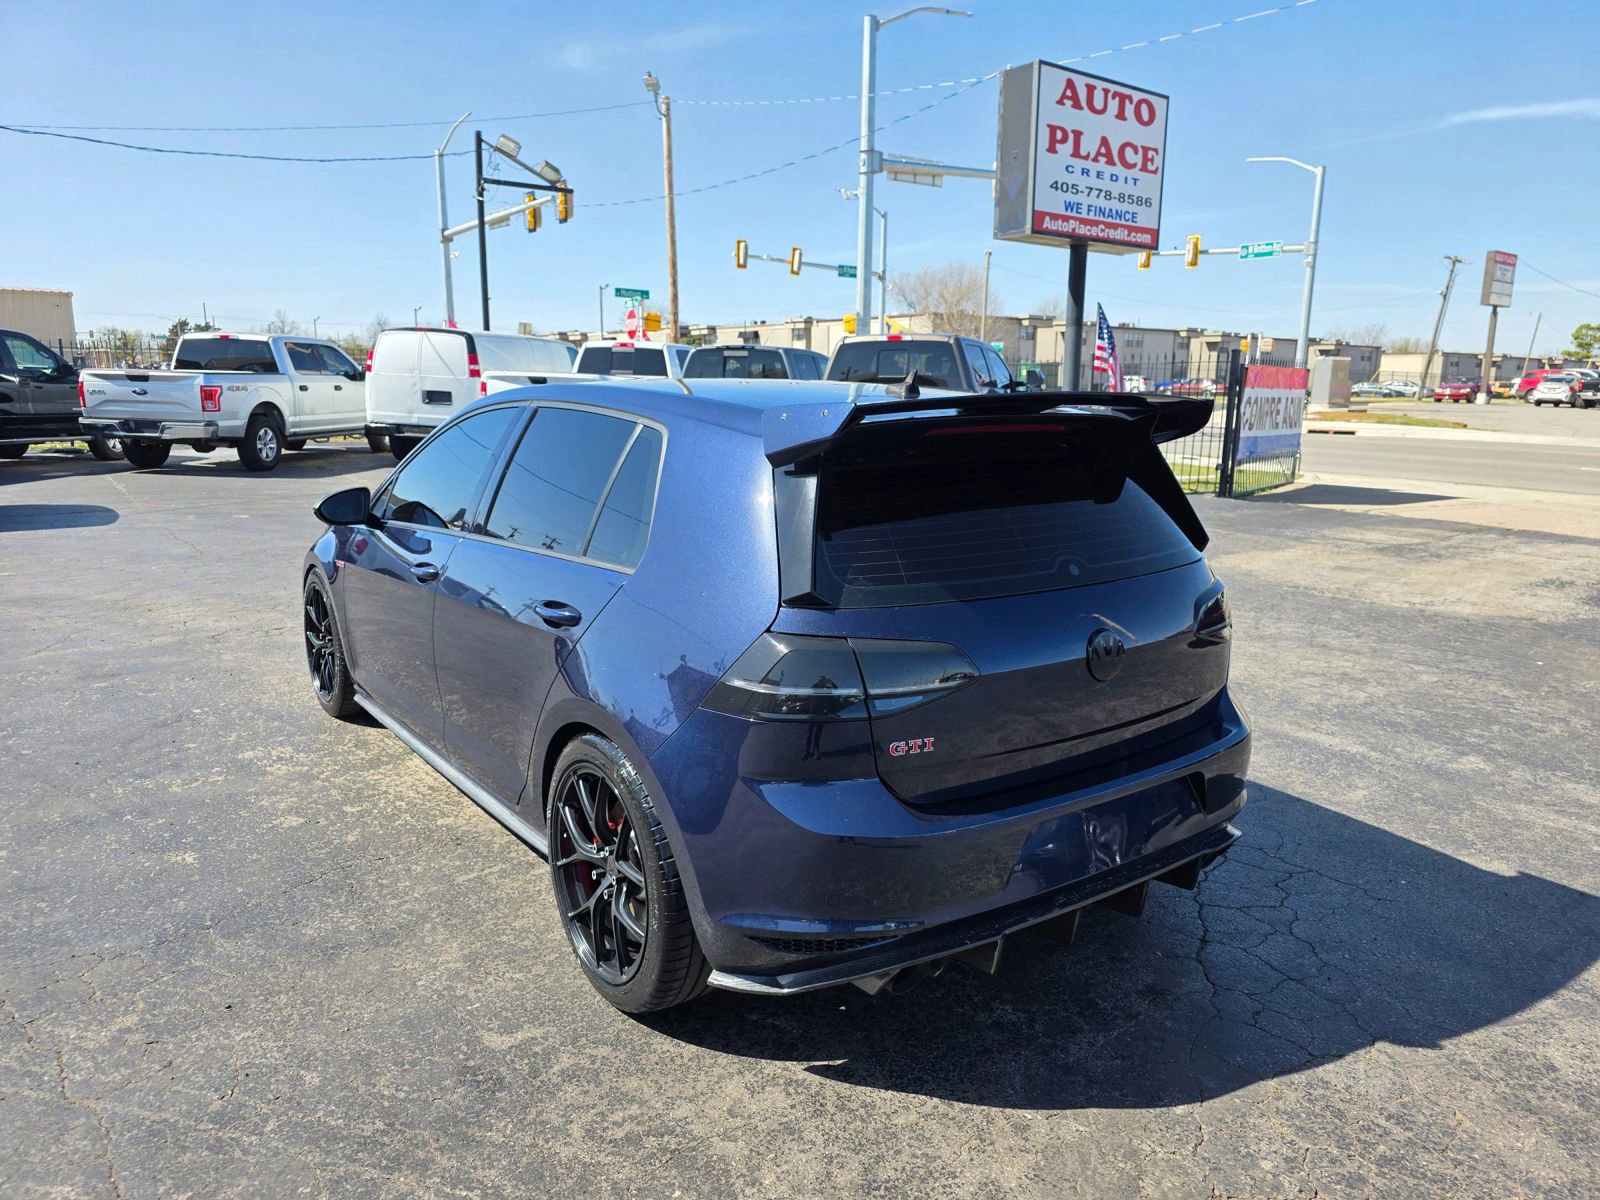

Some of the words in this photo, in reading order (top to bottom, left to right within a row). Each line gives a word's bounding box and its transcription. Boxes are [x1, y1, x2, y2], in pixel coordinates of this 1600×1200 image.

[1056, 77, 1156, 127] AUTO
[1046, 123, 1159, 175] PLACE
[1065, 164, 1140, 186] CREDIT
[1049, 180, 1153, 208] 405-778-8586
[1063, 200, 1083, 214] WE
[1087, 204, 1138, 223] FINANCE
[1043, 215, 1152, 244] AutoPlaceCredit.com
[1242, 395, 1281, 431] COMPRE
[889, 737, 935, 757] GTI
